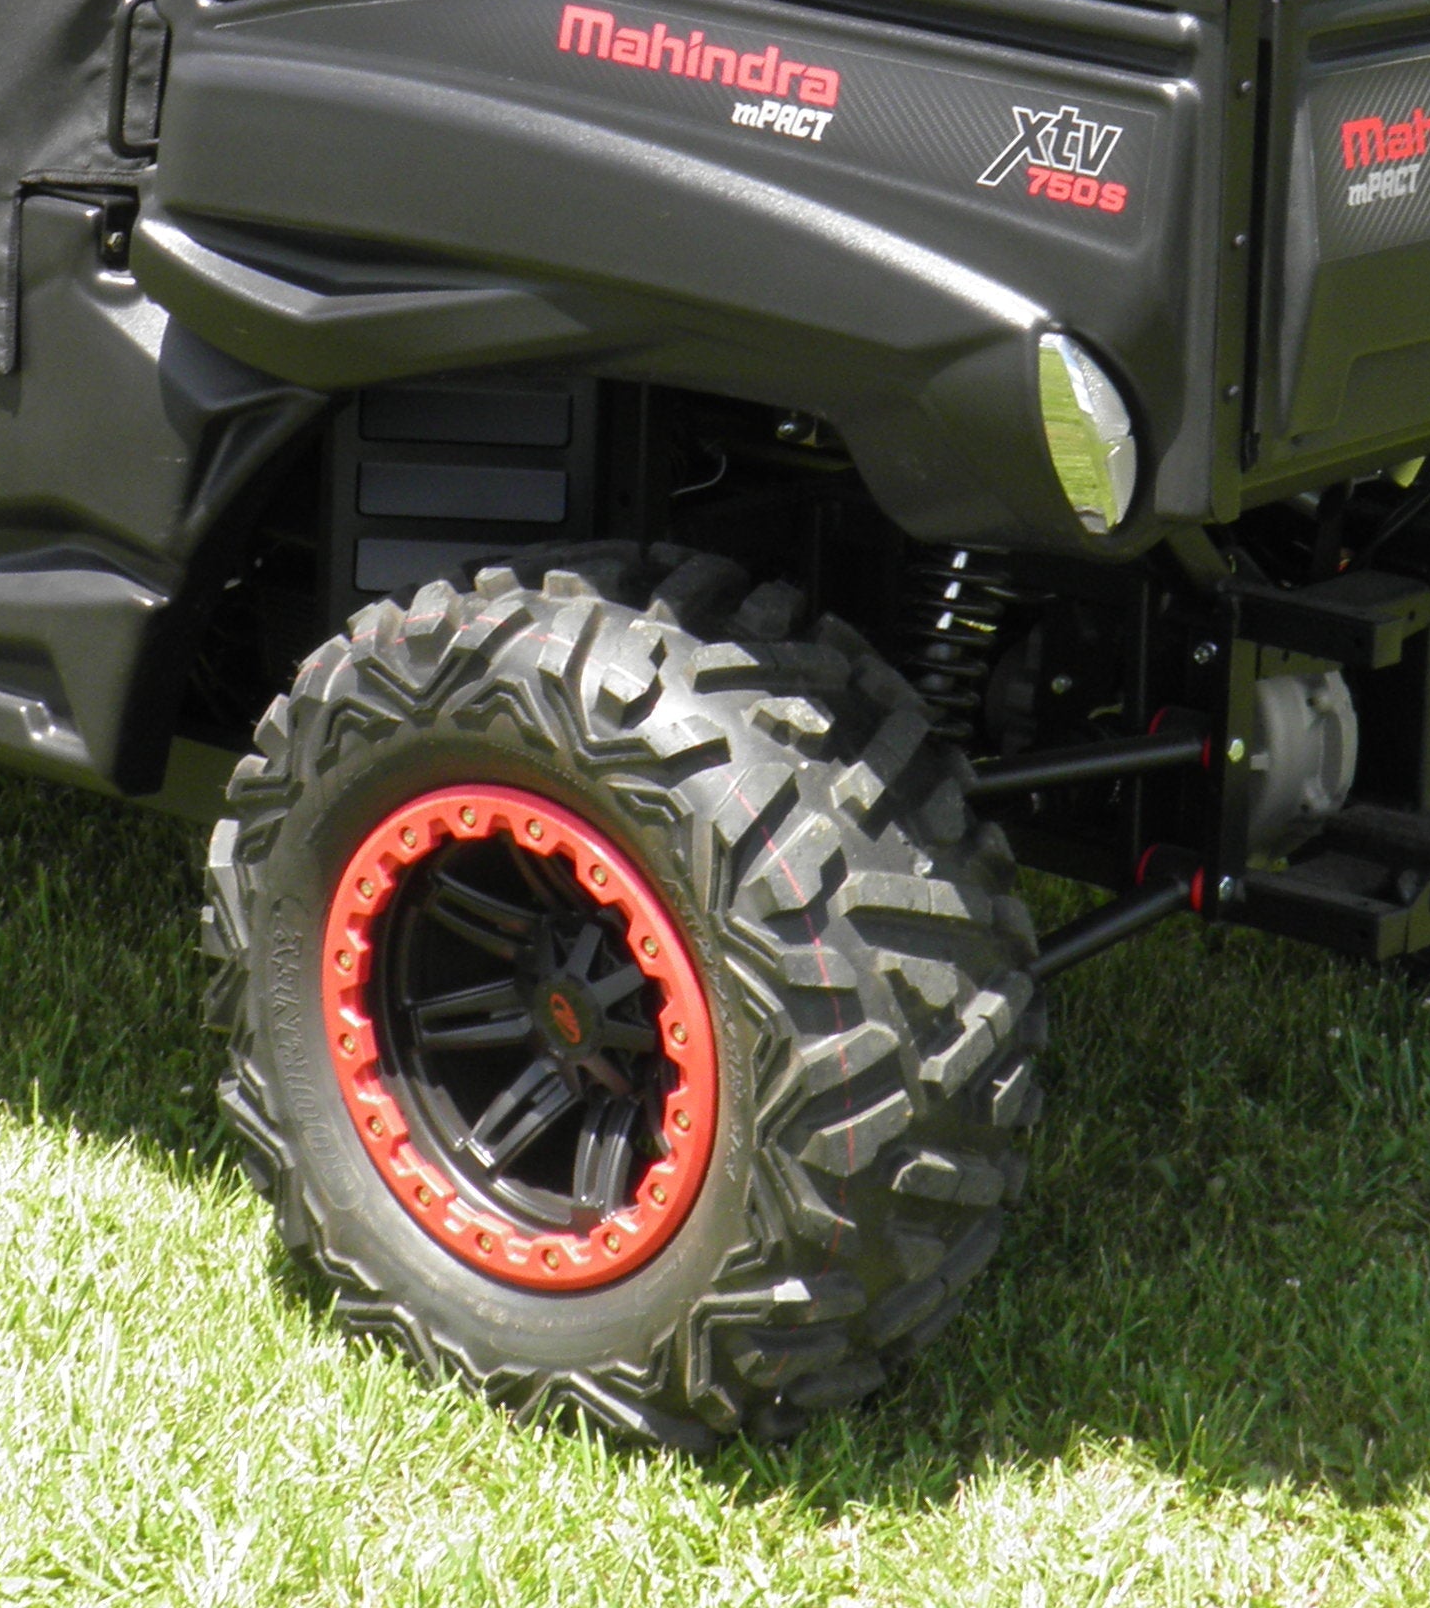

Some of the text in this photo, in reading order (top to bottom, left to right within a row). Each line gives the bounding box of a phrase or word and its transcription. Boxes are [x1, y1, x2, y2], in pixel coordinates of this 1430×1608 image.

[557, 3, 841, 108] Mahindra
[730, 100, 834, 142] mPACT
[1027, 166, 1129, 214] 750S
[1348, 163, 1421, 207] mPACT
